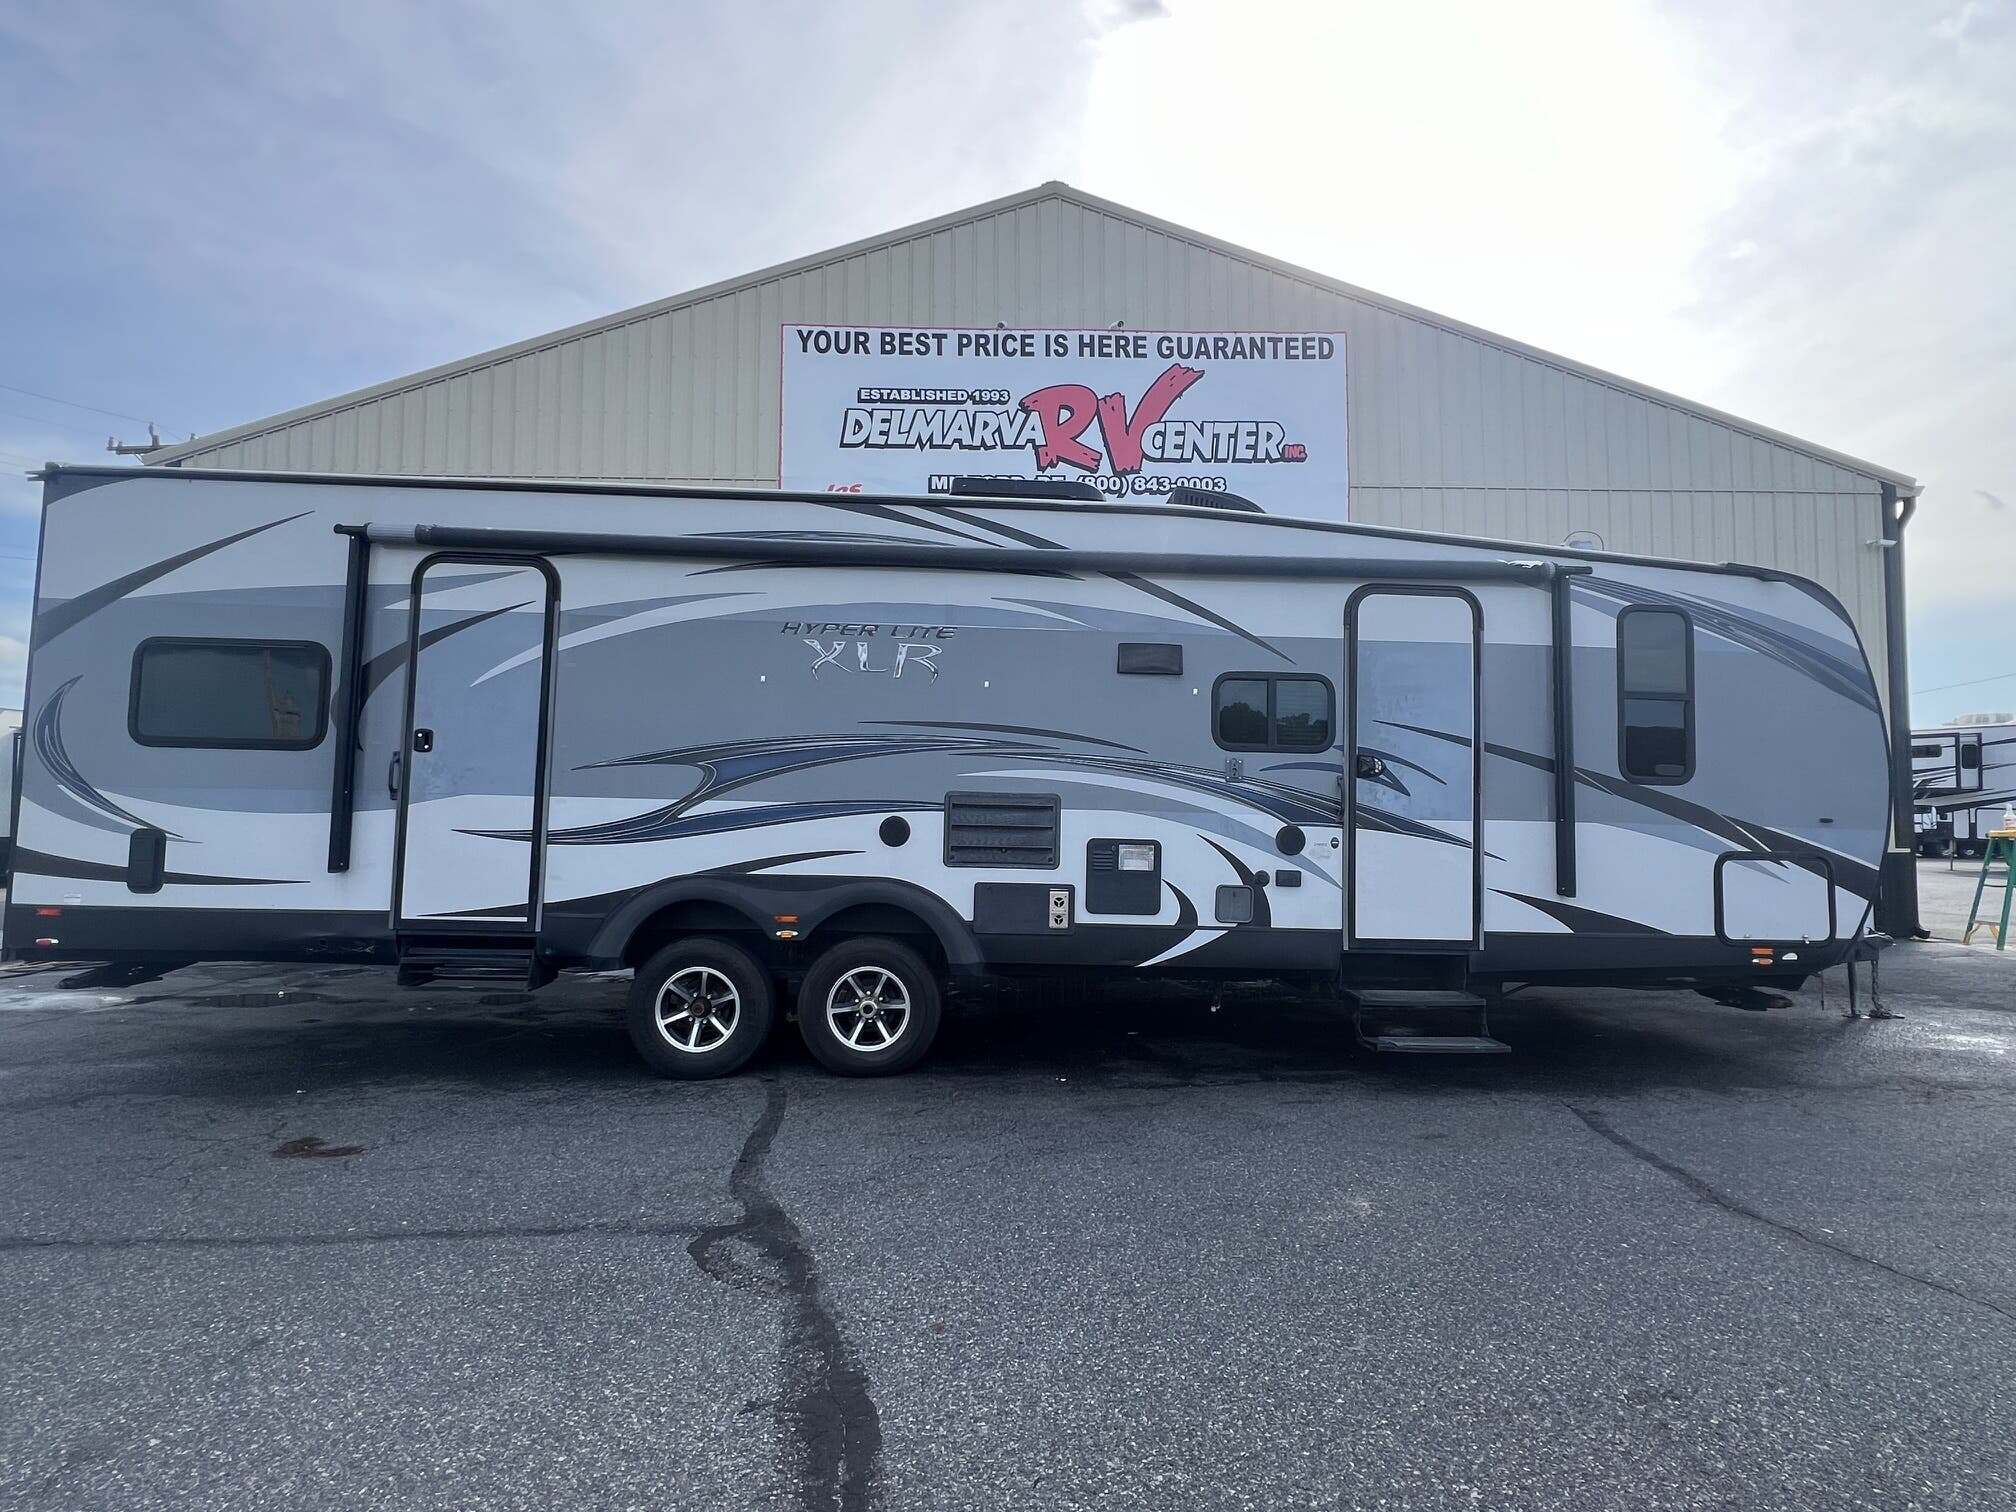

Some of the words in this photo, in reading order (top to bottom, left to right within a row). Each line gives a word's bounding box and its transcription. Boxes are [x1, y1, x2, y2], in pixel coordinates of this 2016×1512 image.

[797, 329, 871, 356] YOUR
[880, 332, 949, 356] BEST
[957, 333, 1035, 357] PRICE
[1045, 334, 1069, 357] IS
[1078, 334, 1148, 359] HERE
[1156, 336, 1335, 360] GUARANTEED
[858, 388, 969, 403] ESTABLISHED
[971, 389, 1010, 404] 1993
[840, 408, 1047, 450] DELMARVA
[1019, 363, 1205, 475] RV
[1140, 420, 1285, 463] CENTER
[780, 622, 880, 637] HYPER
[890, 625, 958, 639] LITE
[803, 638, 943, 687] XLR
